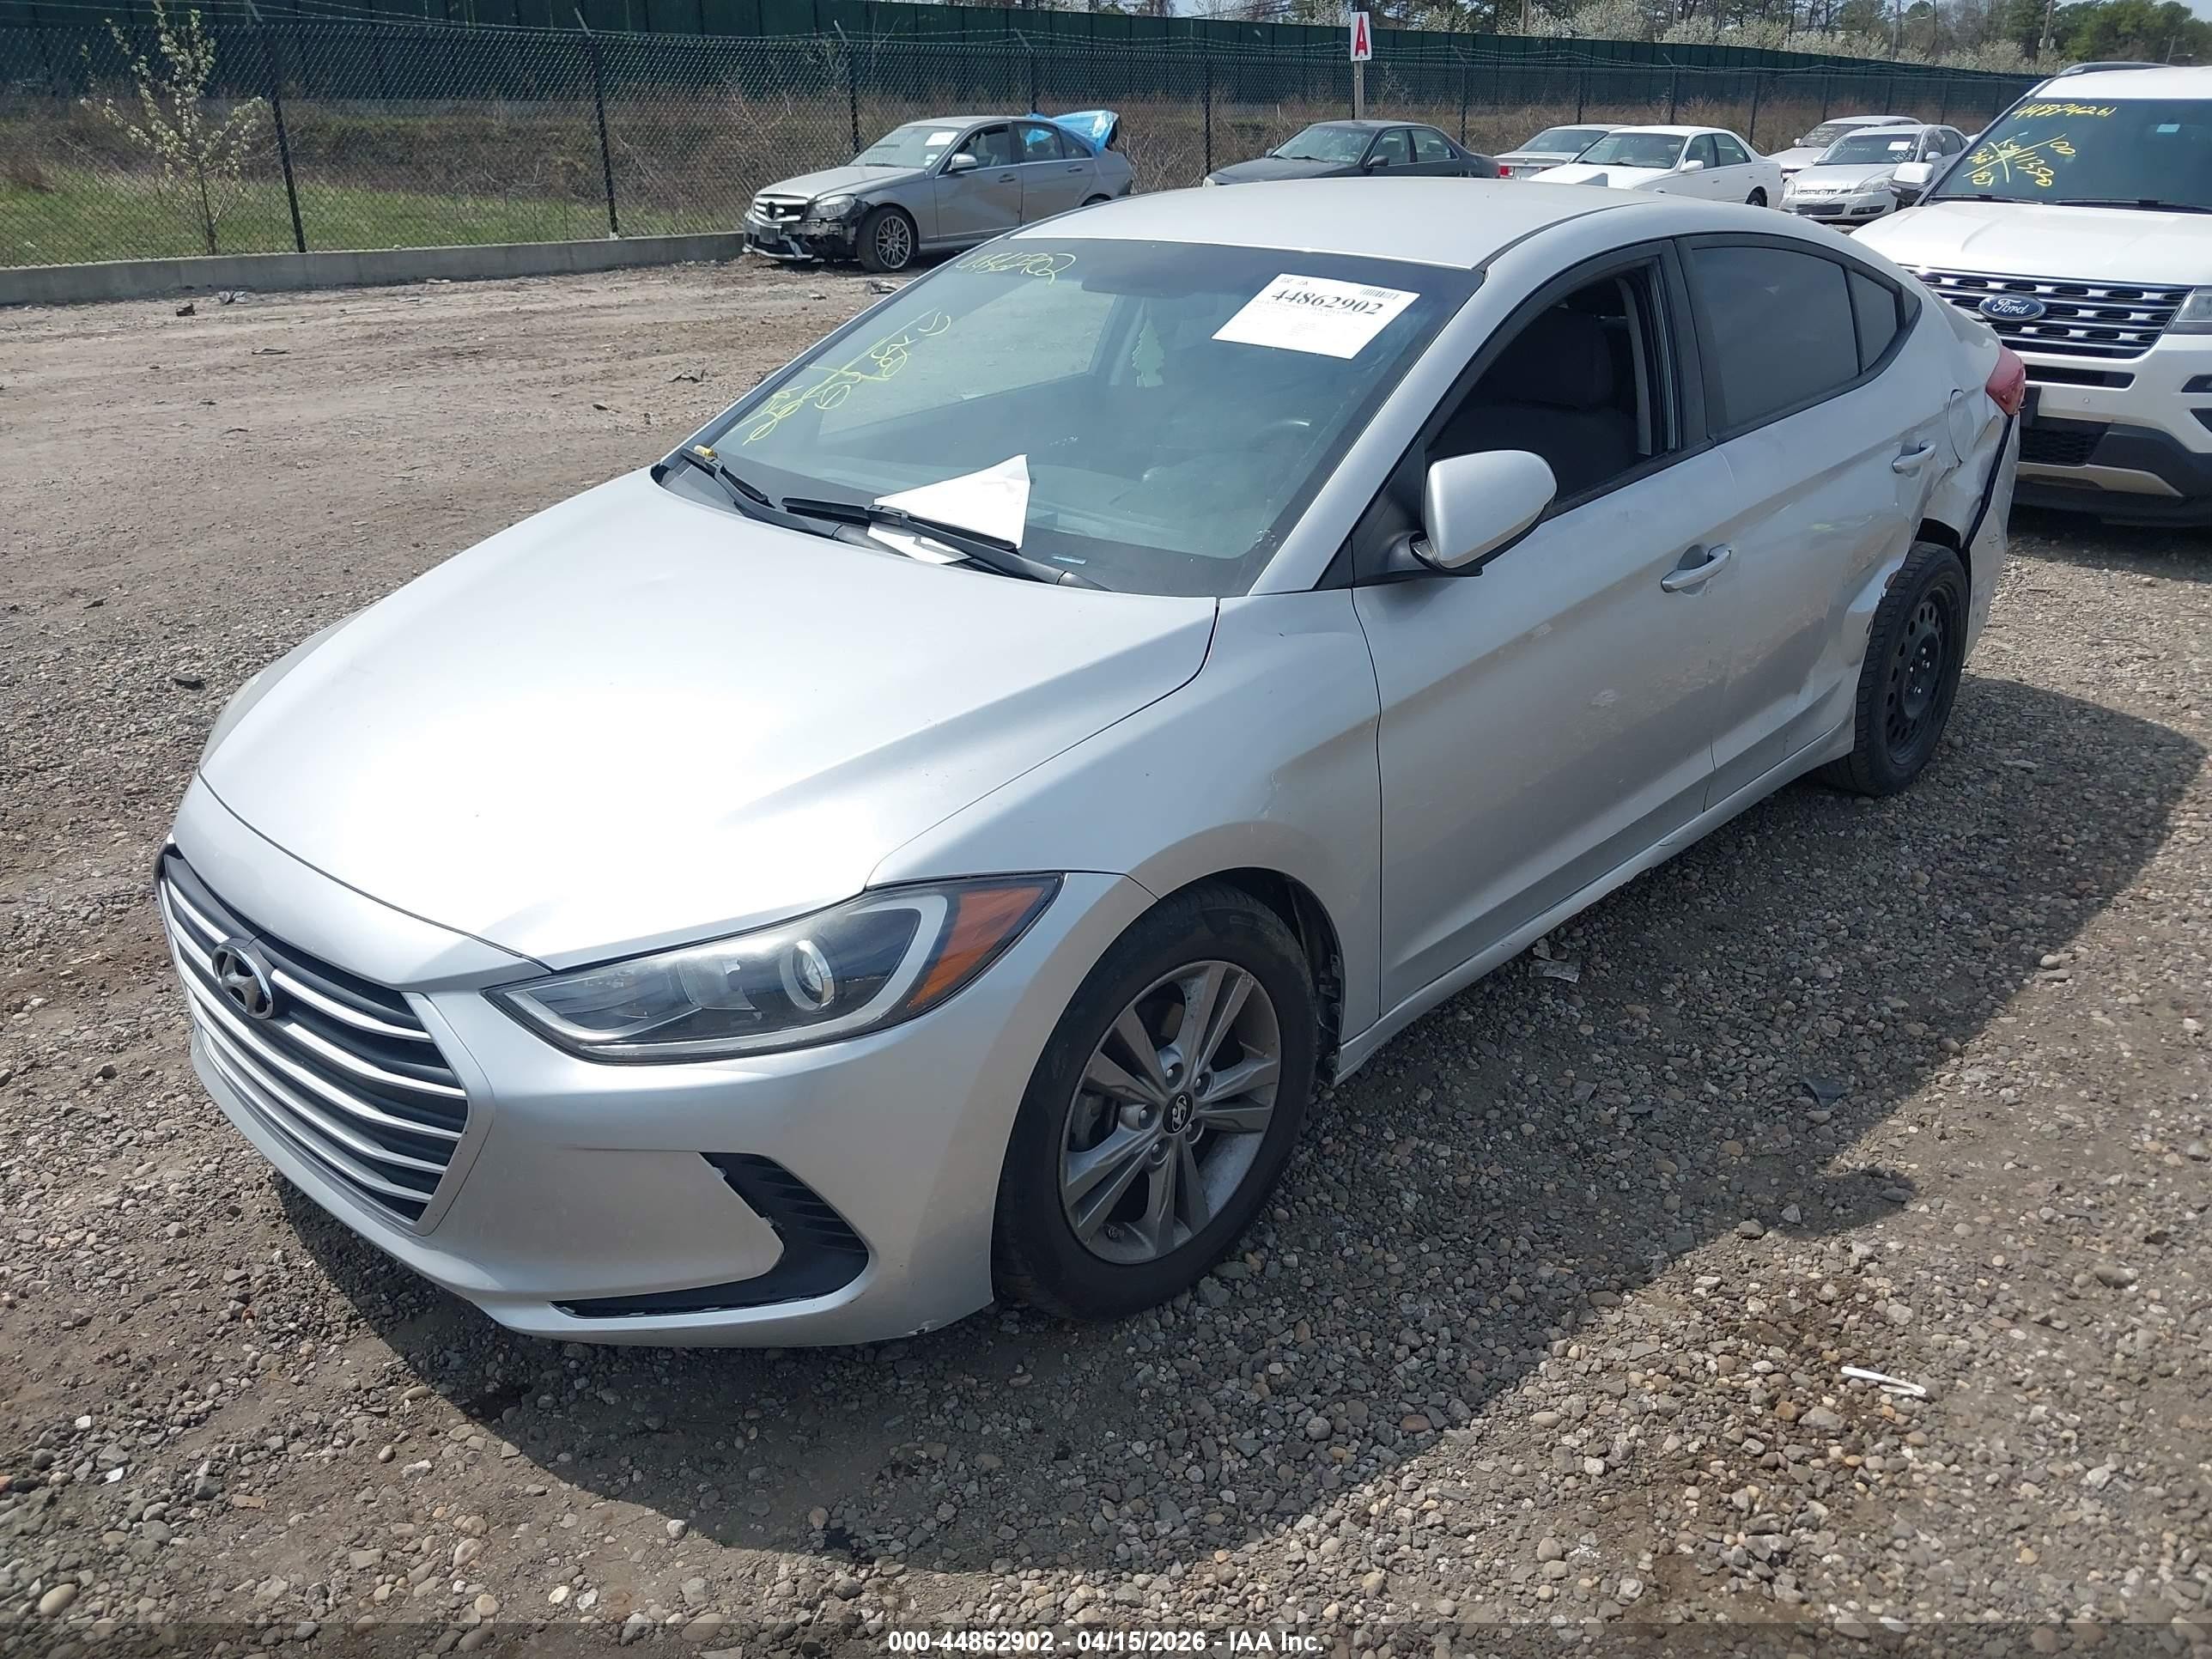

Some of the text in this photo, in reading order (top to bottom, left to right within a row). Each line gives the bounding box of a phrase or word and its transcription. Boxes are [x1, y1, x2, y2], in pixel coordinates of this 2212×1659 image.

[1355, 13, 1369, 57] A
[1271, 289, 1383, 315] 44862902
[1992, 298, 2030, 314] Ford
